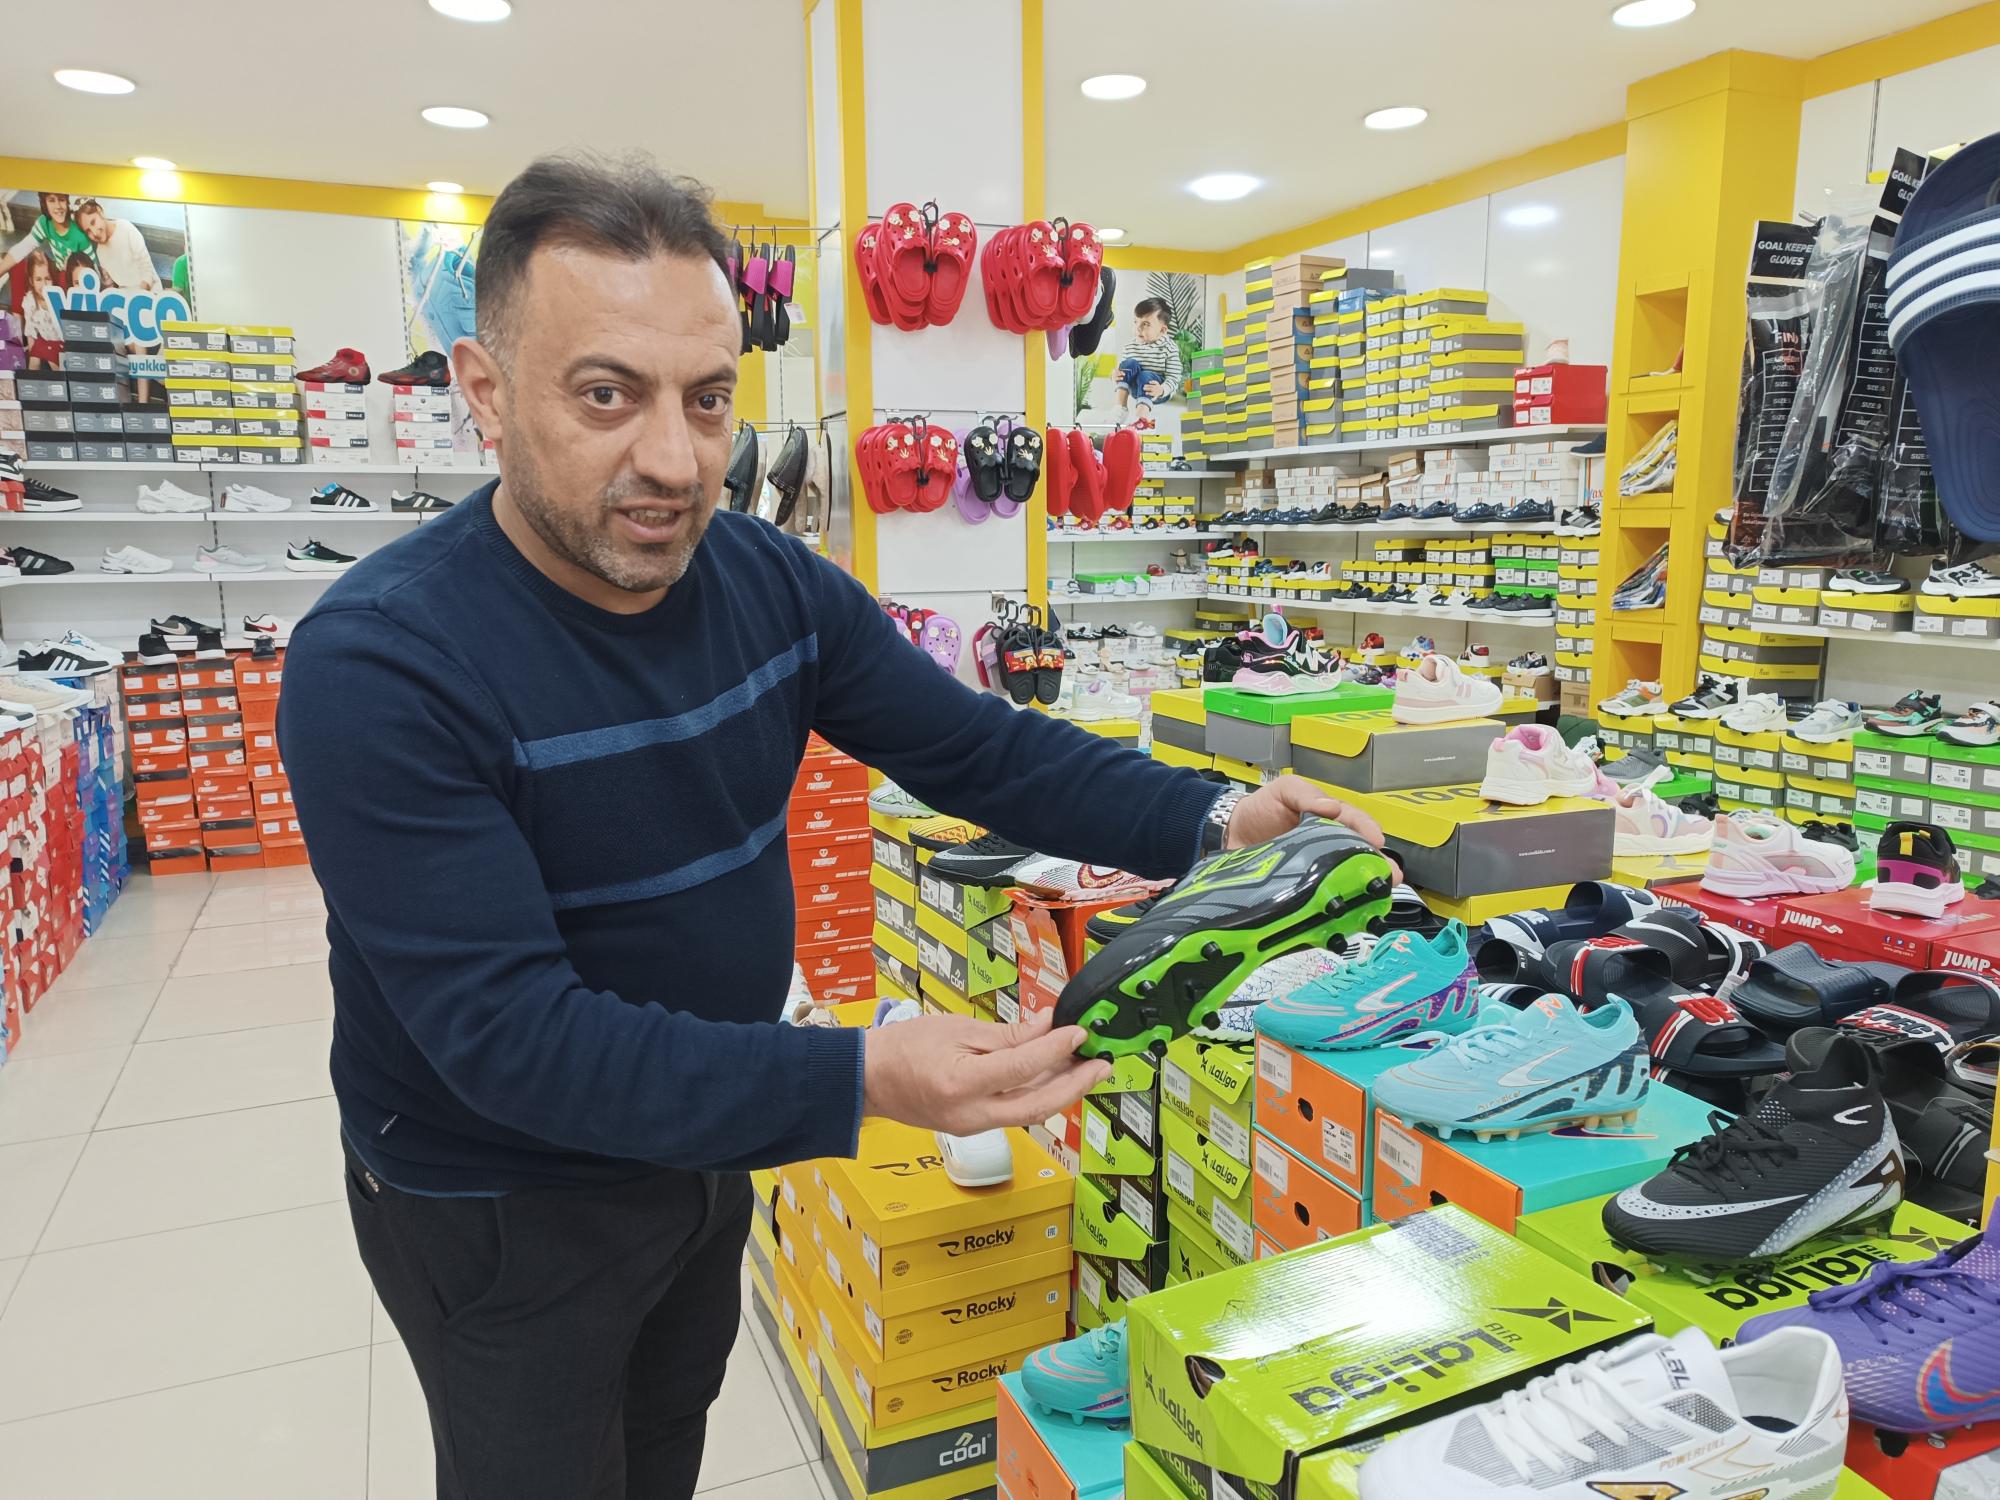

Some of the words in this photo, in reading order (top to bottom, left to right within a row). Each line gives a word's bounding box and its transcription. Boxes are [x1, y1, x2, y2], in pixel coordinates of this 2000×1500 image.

[1891, 170, 1912, 185] GOAL
[1897, 188, 1912, 200] GLO
[1758, 241, 1783, 251] GOAL
[1785, 243, 1814, 253] KEEPE
[1769, 254, 1804, 266] GLOVES
[1781, 909, 1823, 929] JUMP
[1941, 949, 1991, 972] JUMP
[950, 973, 965, 993] cool
[964, 1228, 1014, 1249] Rocky
[966, 1294, 1015, 1318] Rocky
[1485, 1322, 1523, 1344] AIR
[957, 1362, 1007, 1386] Rocky
[1289, 1328, 1516, 1416] LaLiga
[939, 1432, 988, 1467] cool
